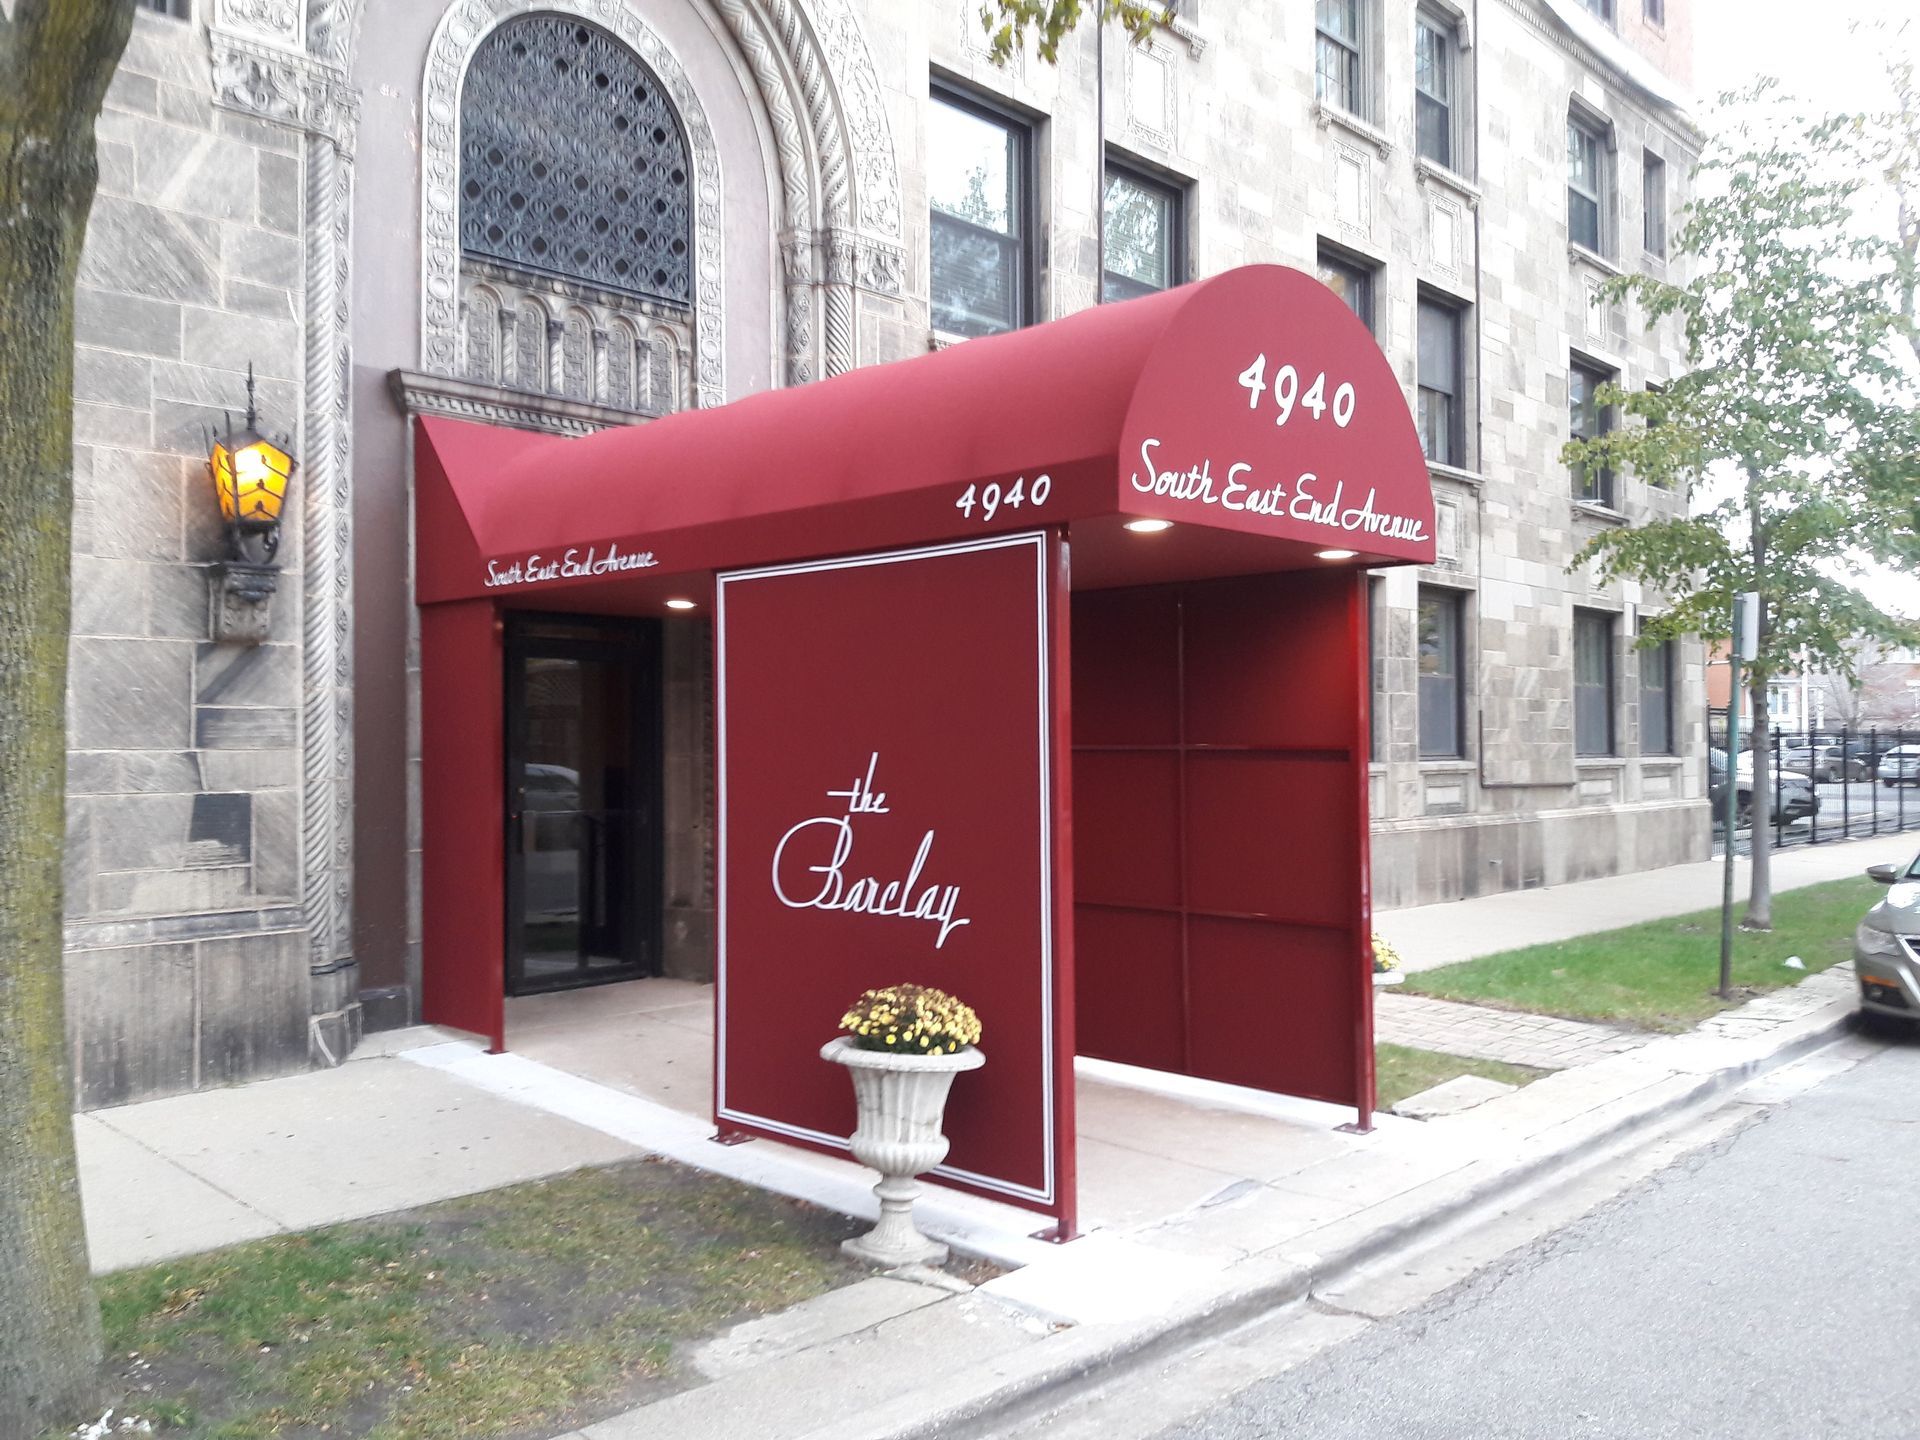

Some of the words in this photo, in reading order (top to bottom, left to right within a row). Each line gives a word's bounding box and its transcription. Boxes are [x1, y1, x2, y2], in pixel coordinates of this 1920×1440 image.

[1238, 353, 1356, 428] 4940
[955, 474, 1052, 522] 4940
[1131, 438, 1218, 504] South
[1221, 462, 1287, 516] East
[1289, 473, 1343, 528] End
[1340, 487, 1430, 542] Avenue
[484, 559, 525, 587] South
[524, 554, 560, 583] East
[560, 546, 595, 578] End
[592, 543, 660, 575] Avenue
[826, 752, 890, 814] the
[771, 814, 971, 950] Barclay
